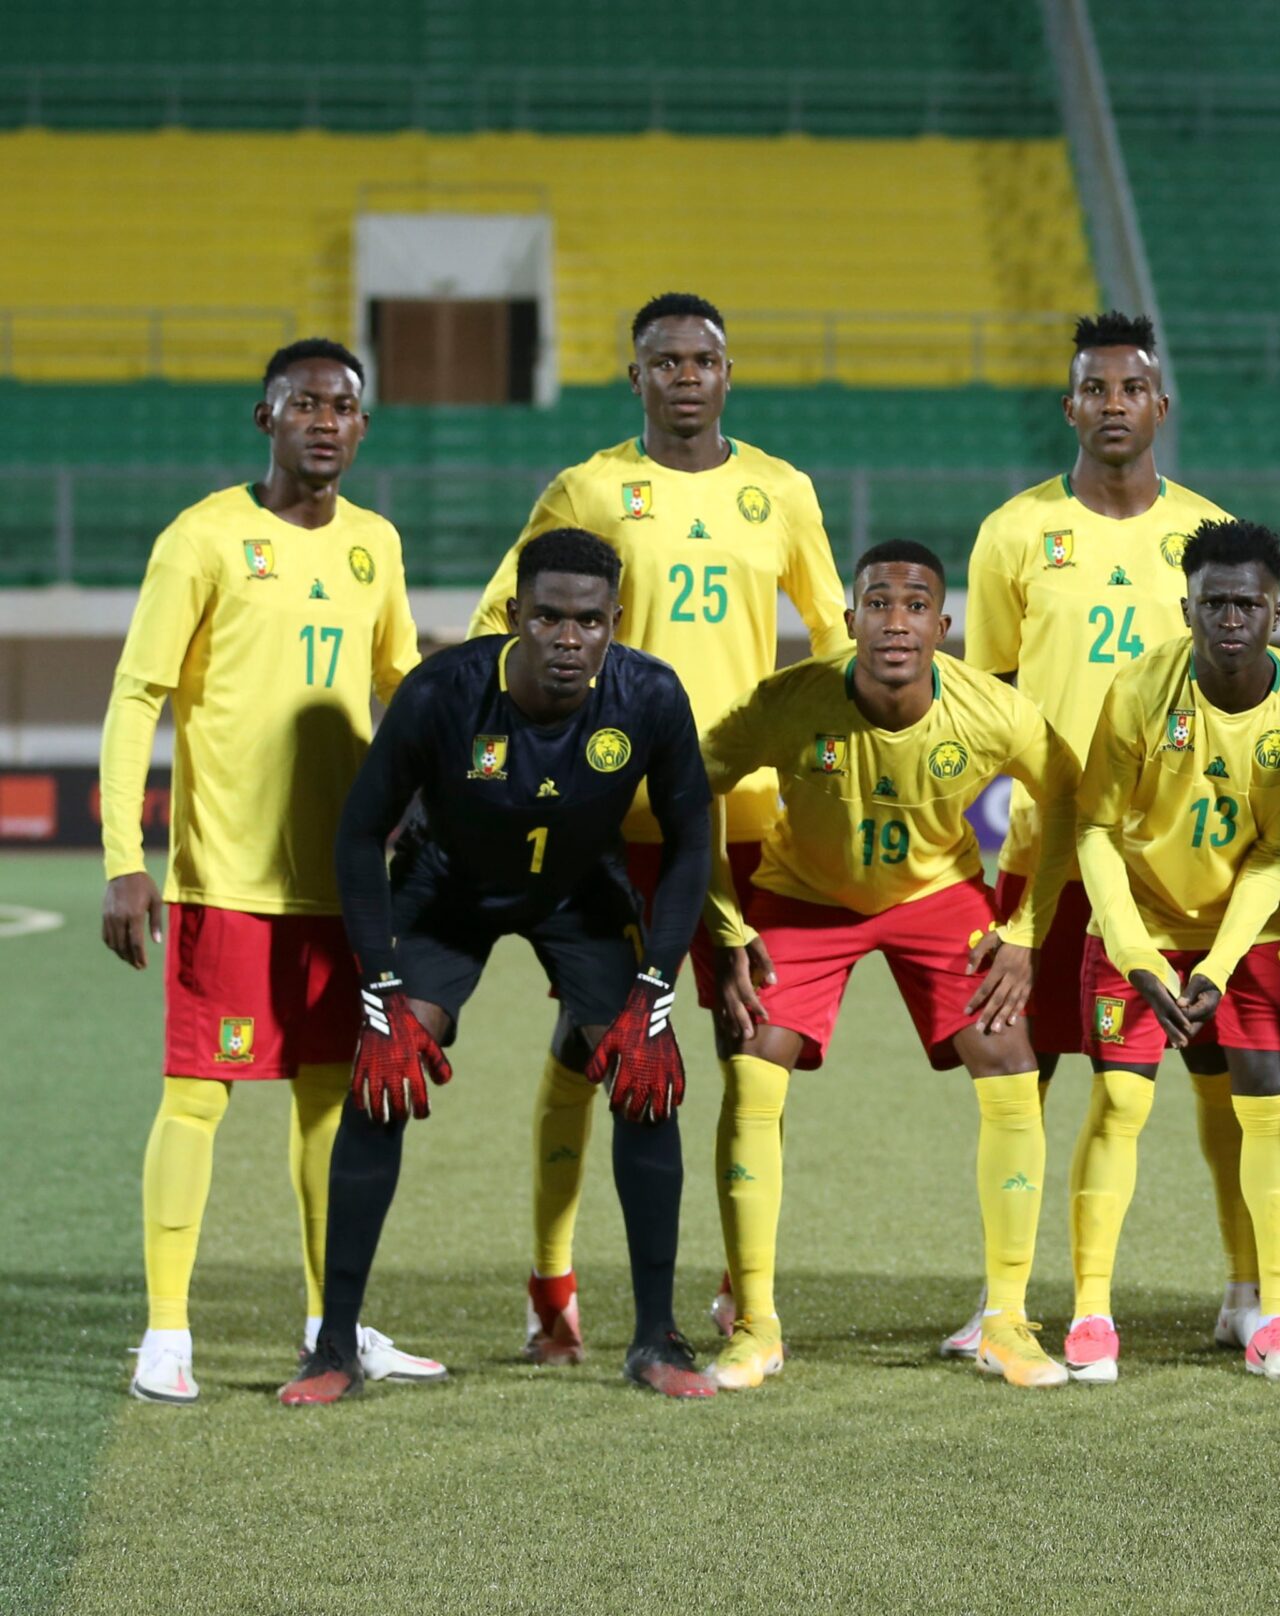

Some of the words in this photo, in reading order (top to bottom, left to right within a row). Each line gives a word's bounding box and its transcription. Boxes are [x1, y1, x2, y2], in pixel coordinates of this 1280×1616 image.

[668, 562, 728, 624] 25
[299, 623, 344, 688] 17
[1088, 605, 1145, 664] 24
[857, 819, 908, 865] 19
[1190, 796, 1239, 848] 13
[526, 827, 548, 873] 1
